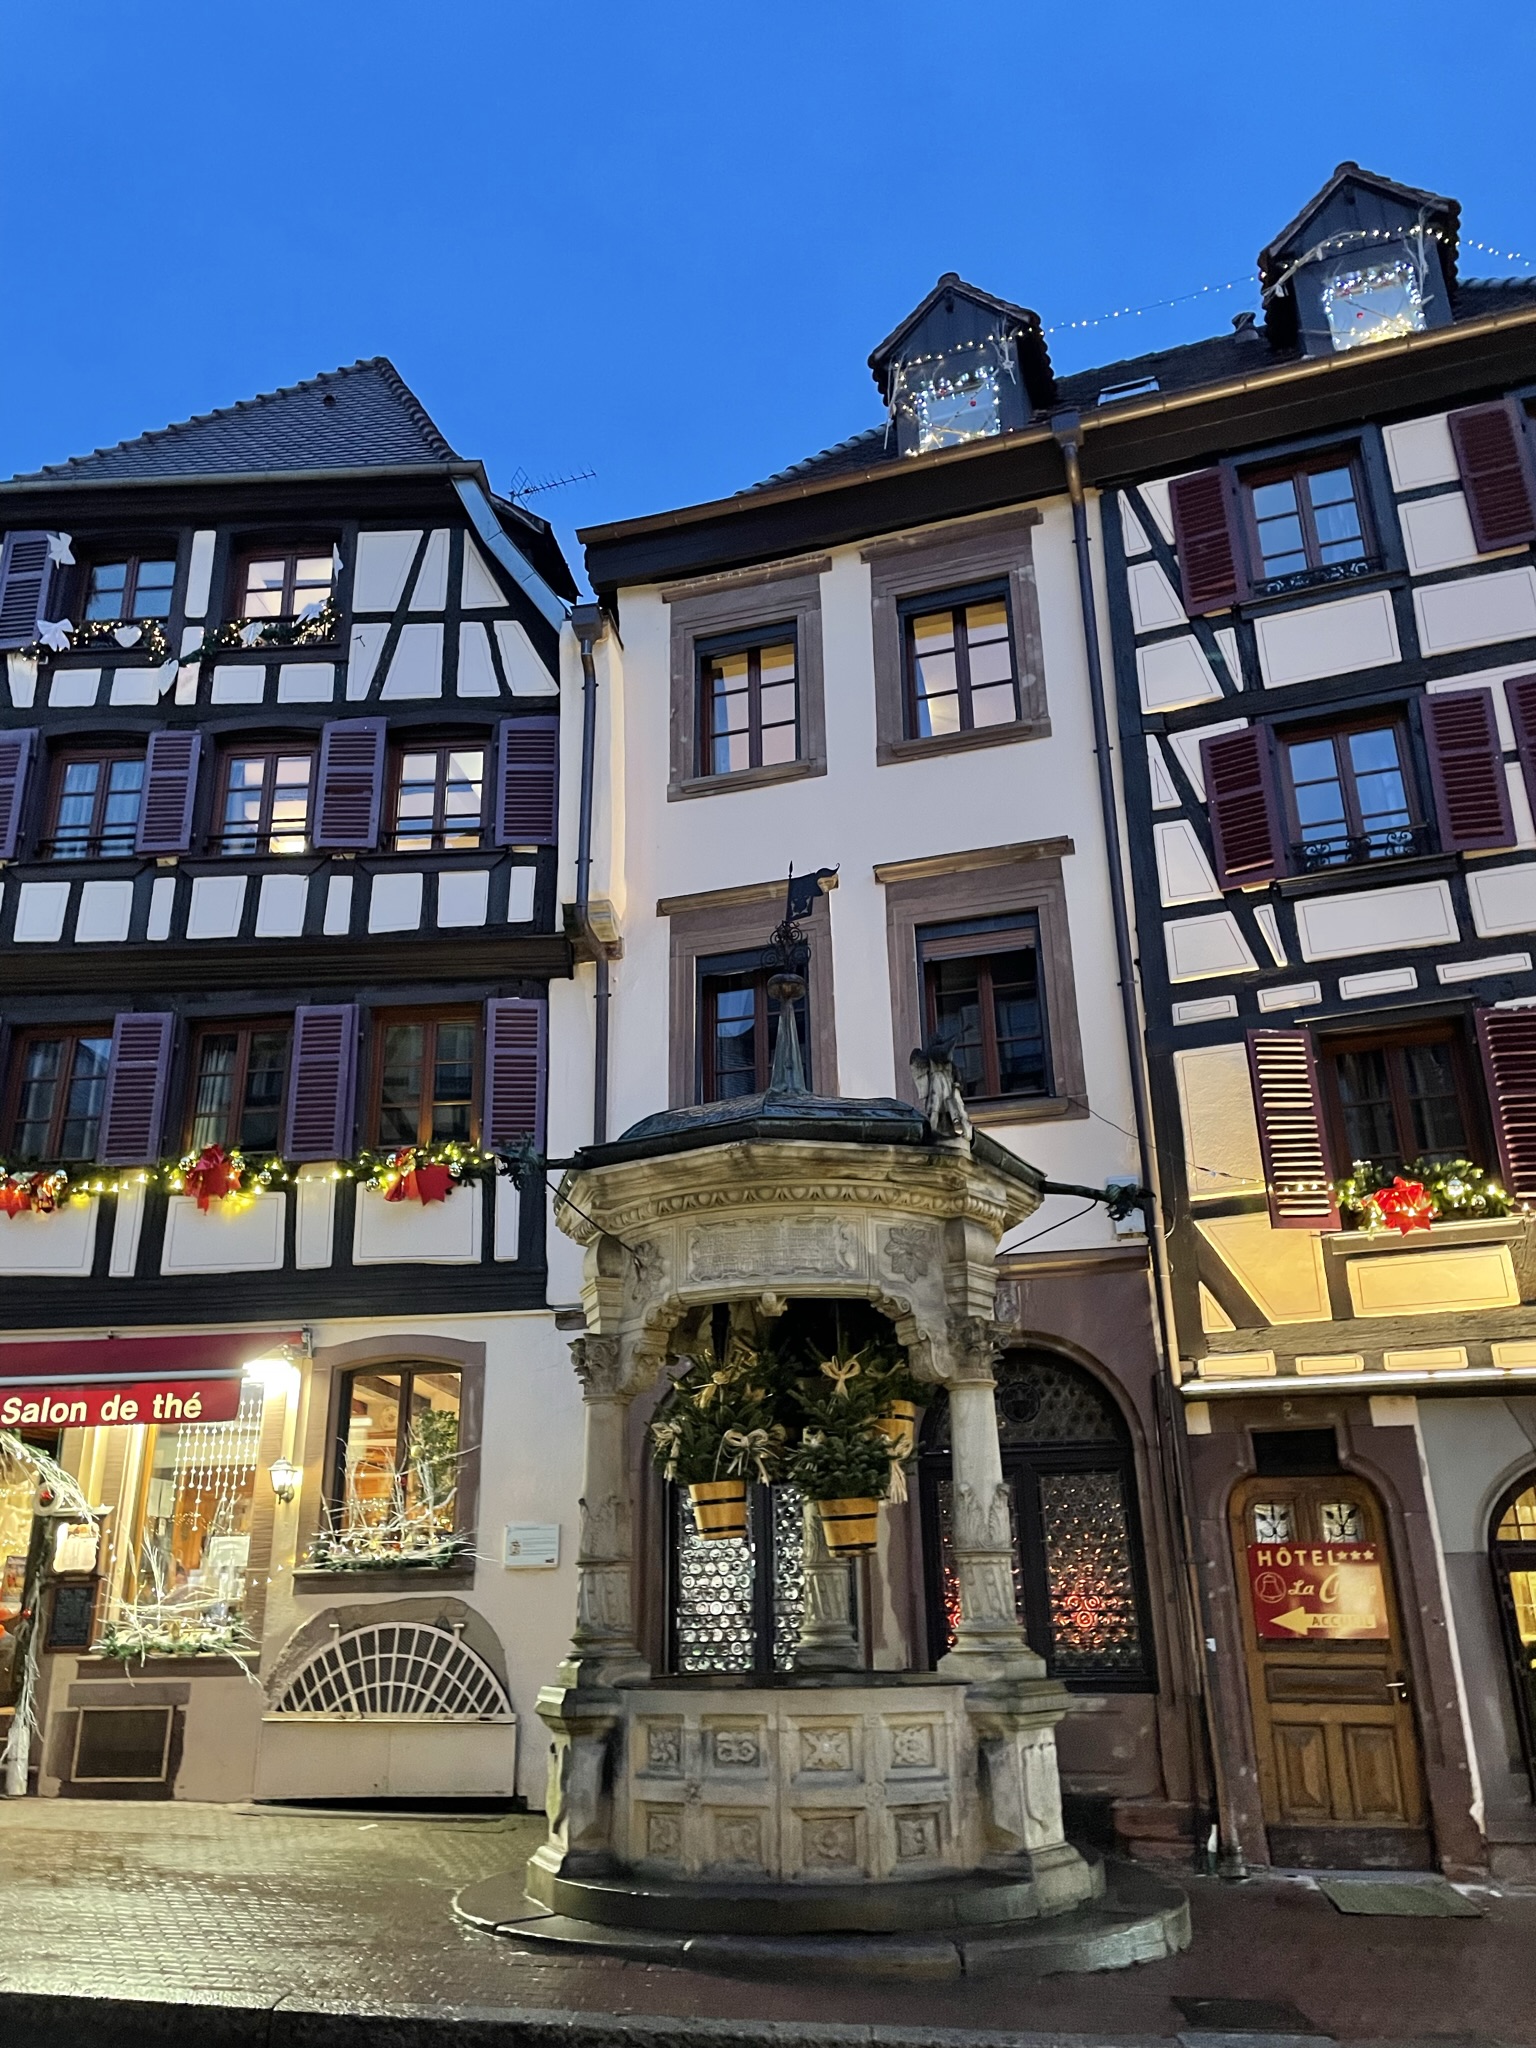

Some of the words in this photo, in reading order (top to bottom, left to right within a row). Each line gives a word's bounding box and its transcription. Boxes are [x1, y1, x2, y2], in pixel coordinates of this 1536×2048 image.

[0, 1397, 88, 1425] Salon
[101, 1394, 139, 1421] de
[152, 1392, 202, 1419] thé
[1257, 1547, 1340, 1567] HÔTEL
[1288, 1580, 1315, 1596] La
